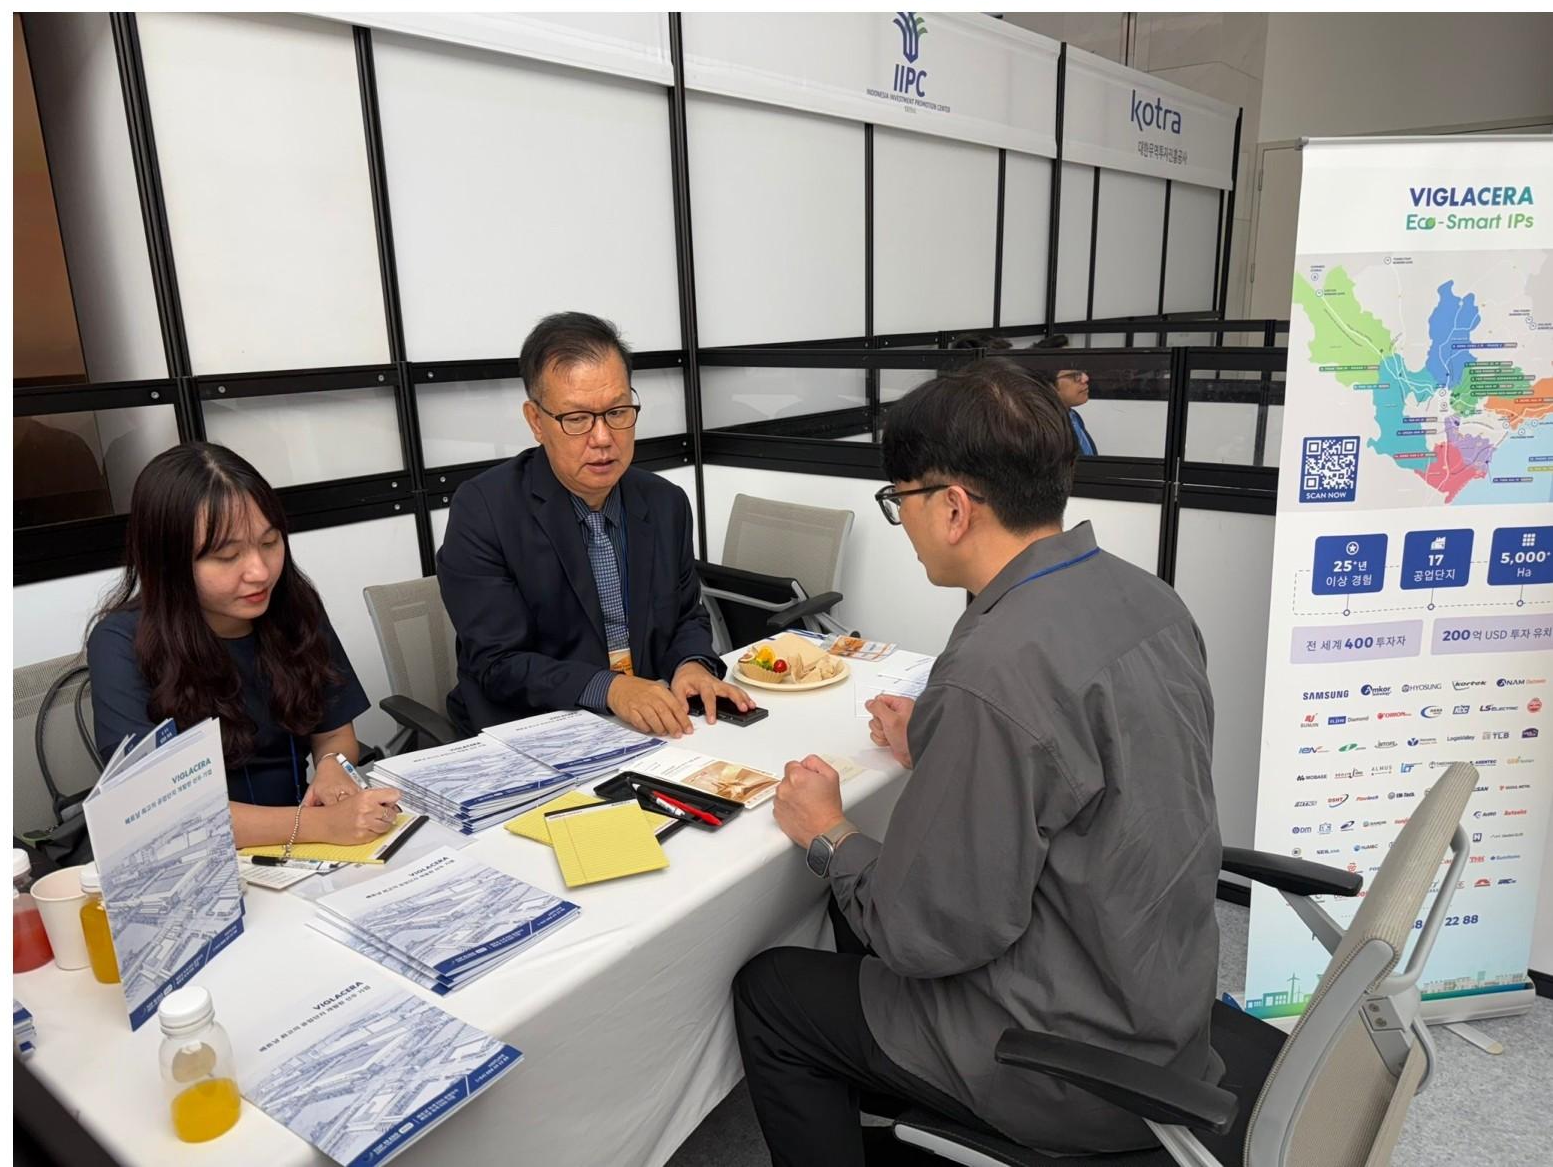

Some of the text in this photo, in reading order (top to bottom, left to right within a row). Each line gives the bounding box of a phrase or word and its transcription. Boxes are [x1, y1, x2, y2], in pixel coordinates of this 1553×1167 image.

[893, 63, 928, 98] IIPC
[1130, 89, 1181, 134] kotra
[1410, 186, 1534, 207] VIGLACERA
[1507, 213, 1534, 229] IPs
[1306, 491, 1347, 500] SCAN NOW
[1428, 554, 1444, 566] 17
[1413, 569, 1455, 582] 공업단지
[1517, 567, 1531, 577] Ha
[1326, 574, 1372, 587] 이상 경험
[1485, 629, 1507, 640] USD
[1510, 628, 1531, 640] 투자
[1533, 627, 1552, 638] 유치
[1306, 635, 1406, 651] 전 세계 400 투자자
[1409, 683, 1442, 691] HYOSUNG
[1302, 690, 1349, 700] SAMSUNG
[171, 757, 212, 784] VIGLACERA
[1445, 915, 1479, 927] 22 88
[312, 981, 364, 1010] VIGLACERA
